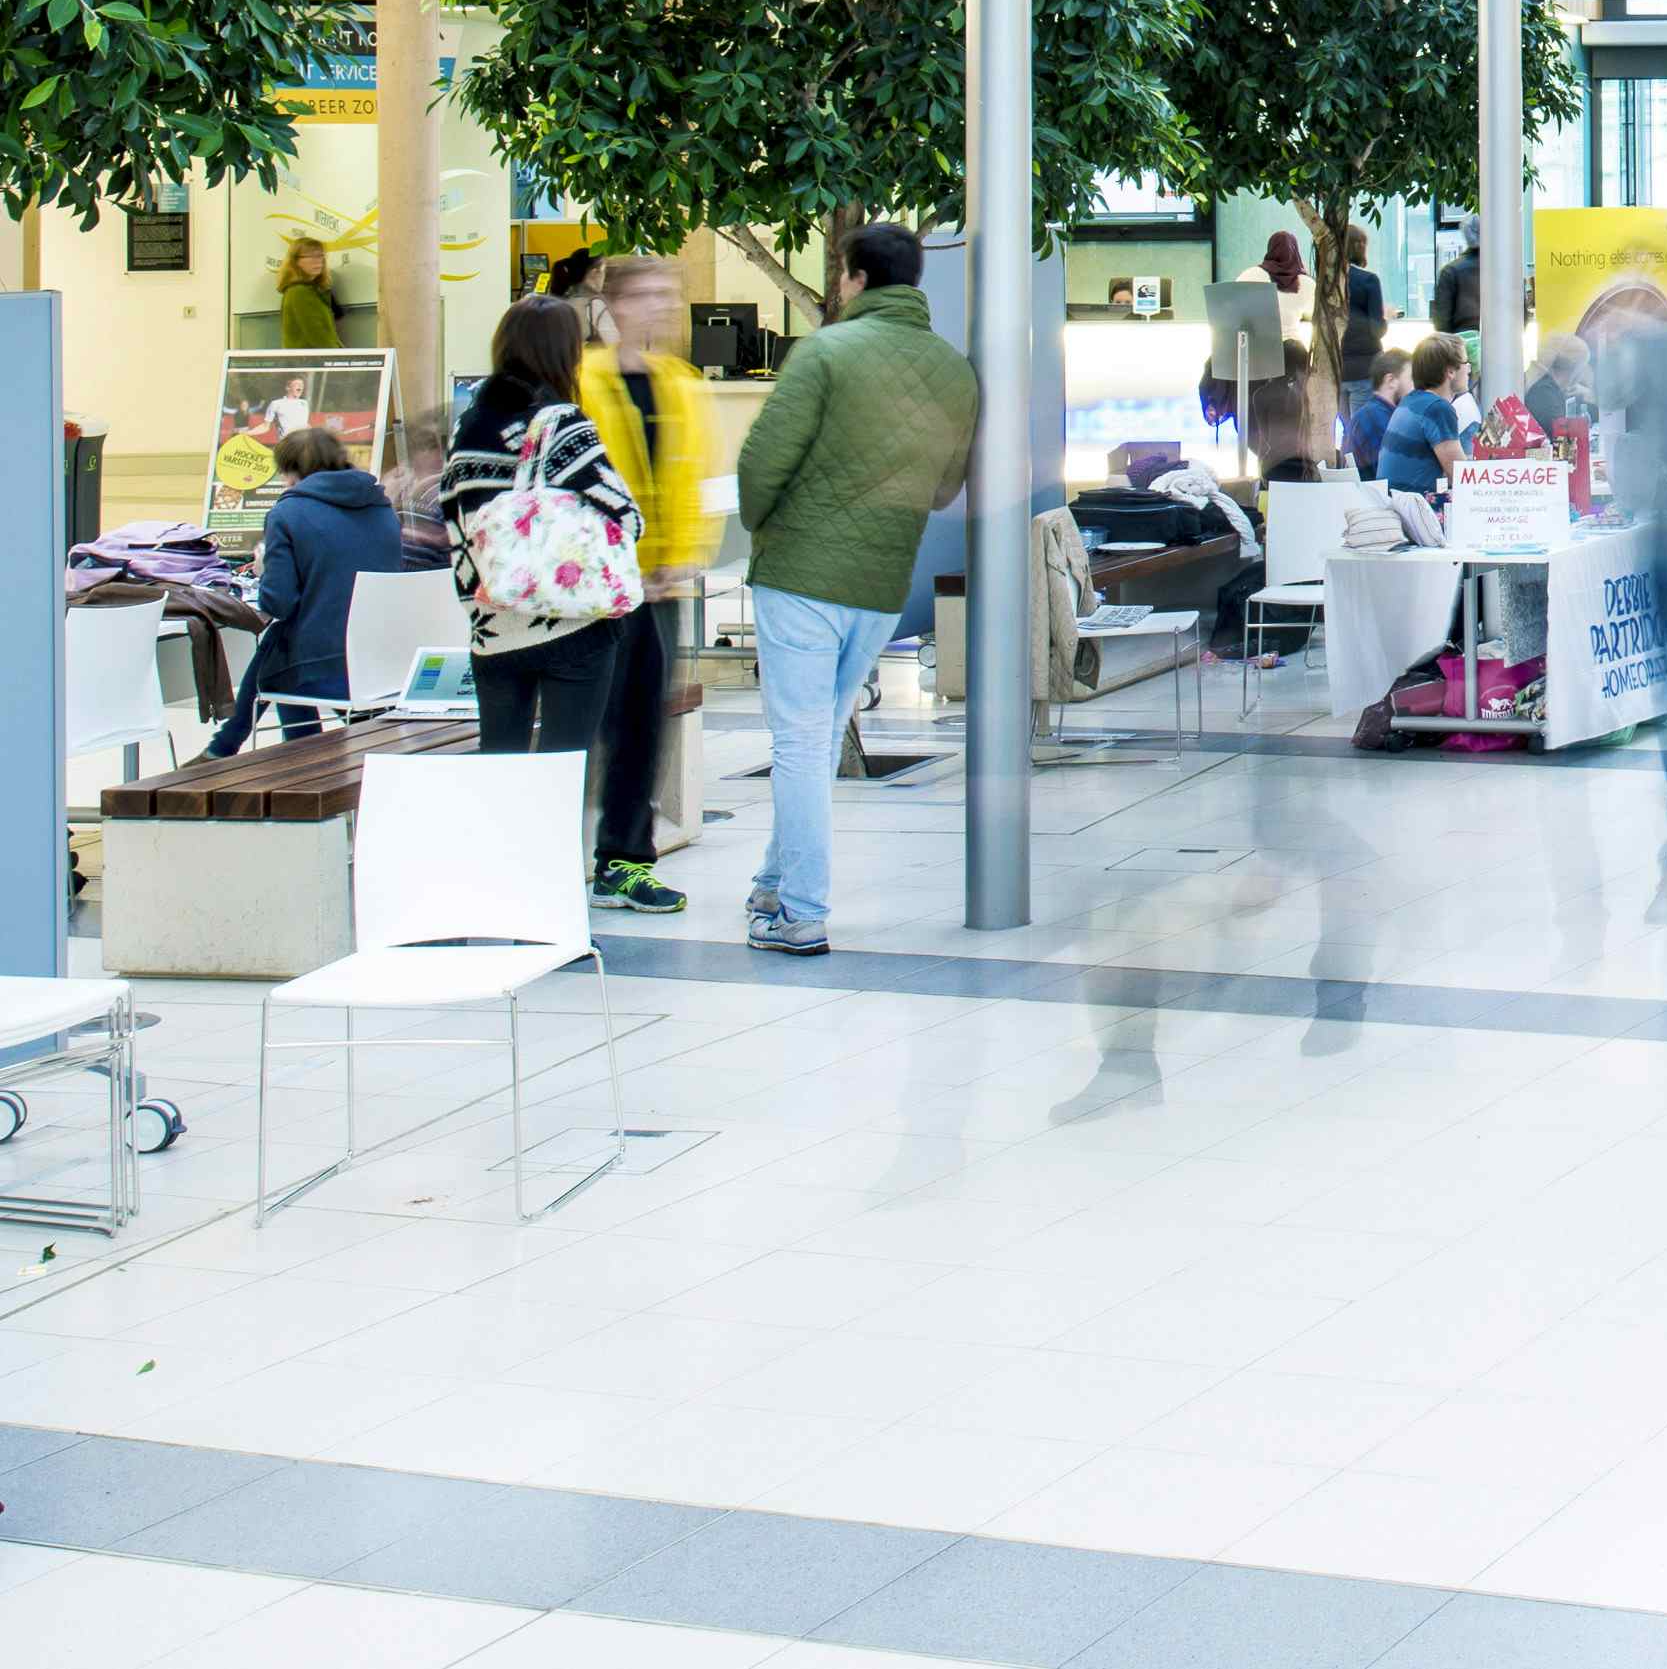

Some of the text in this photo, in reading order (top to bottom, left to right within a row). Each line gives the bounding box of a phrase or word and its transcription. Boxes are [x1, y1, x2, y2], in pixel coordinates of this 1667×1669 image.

[1549, 250, 1606, 270] Nothing
[1460, 467, 1557, 484] MASSAGE
[1603, 572, 1653, 617] DEBBIE
